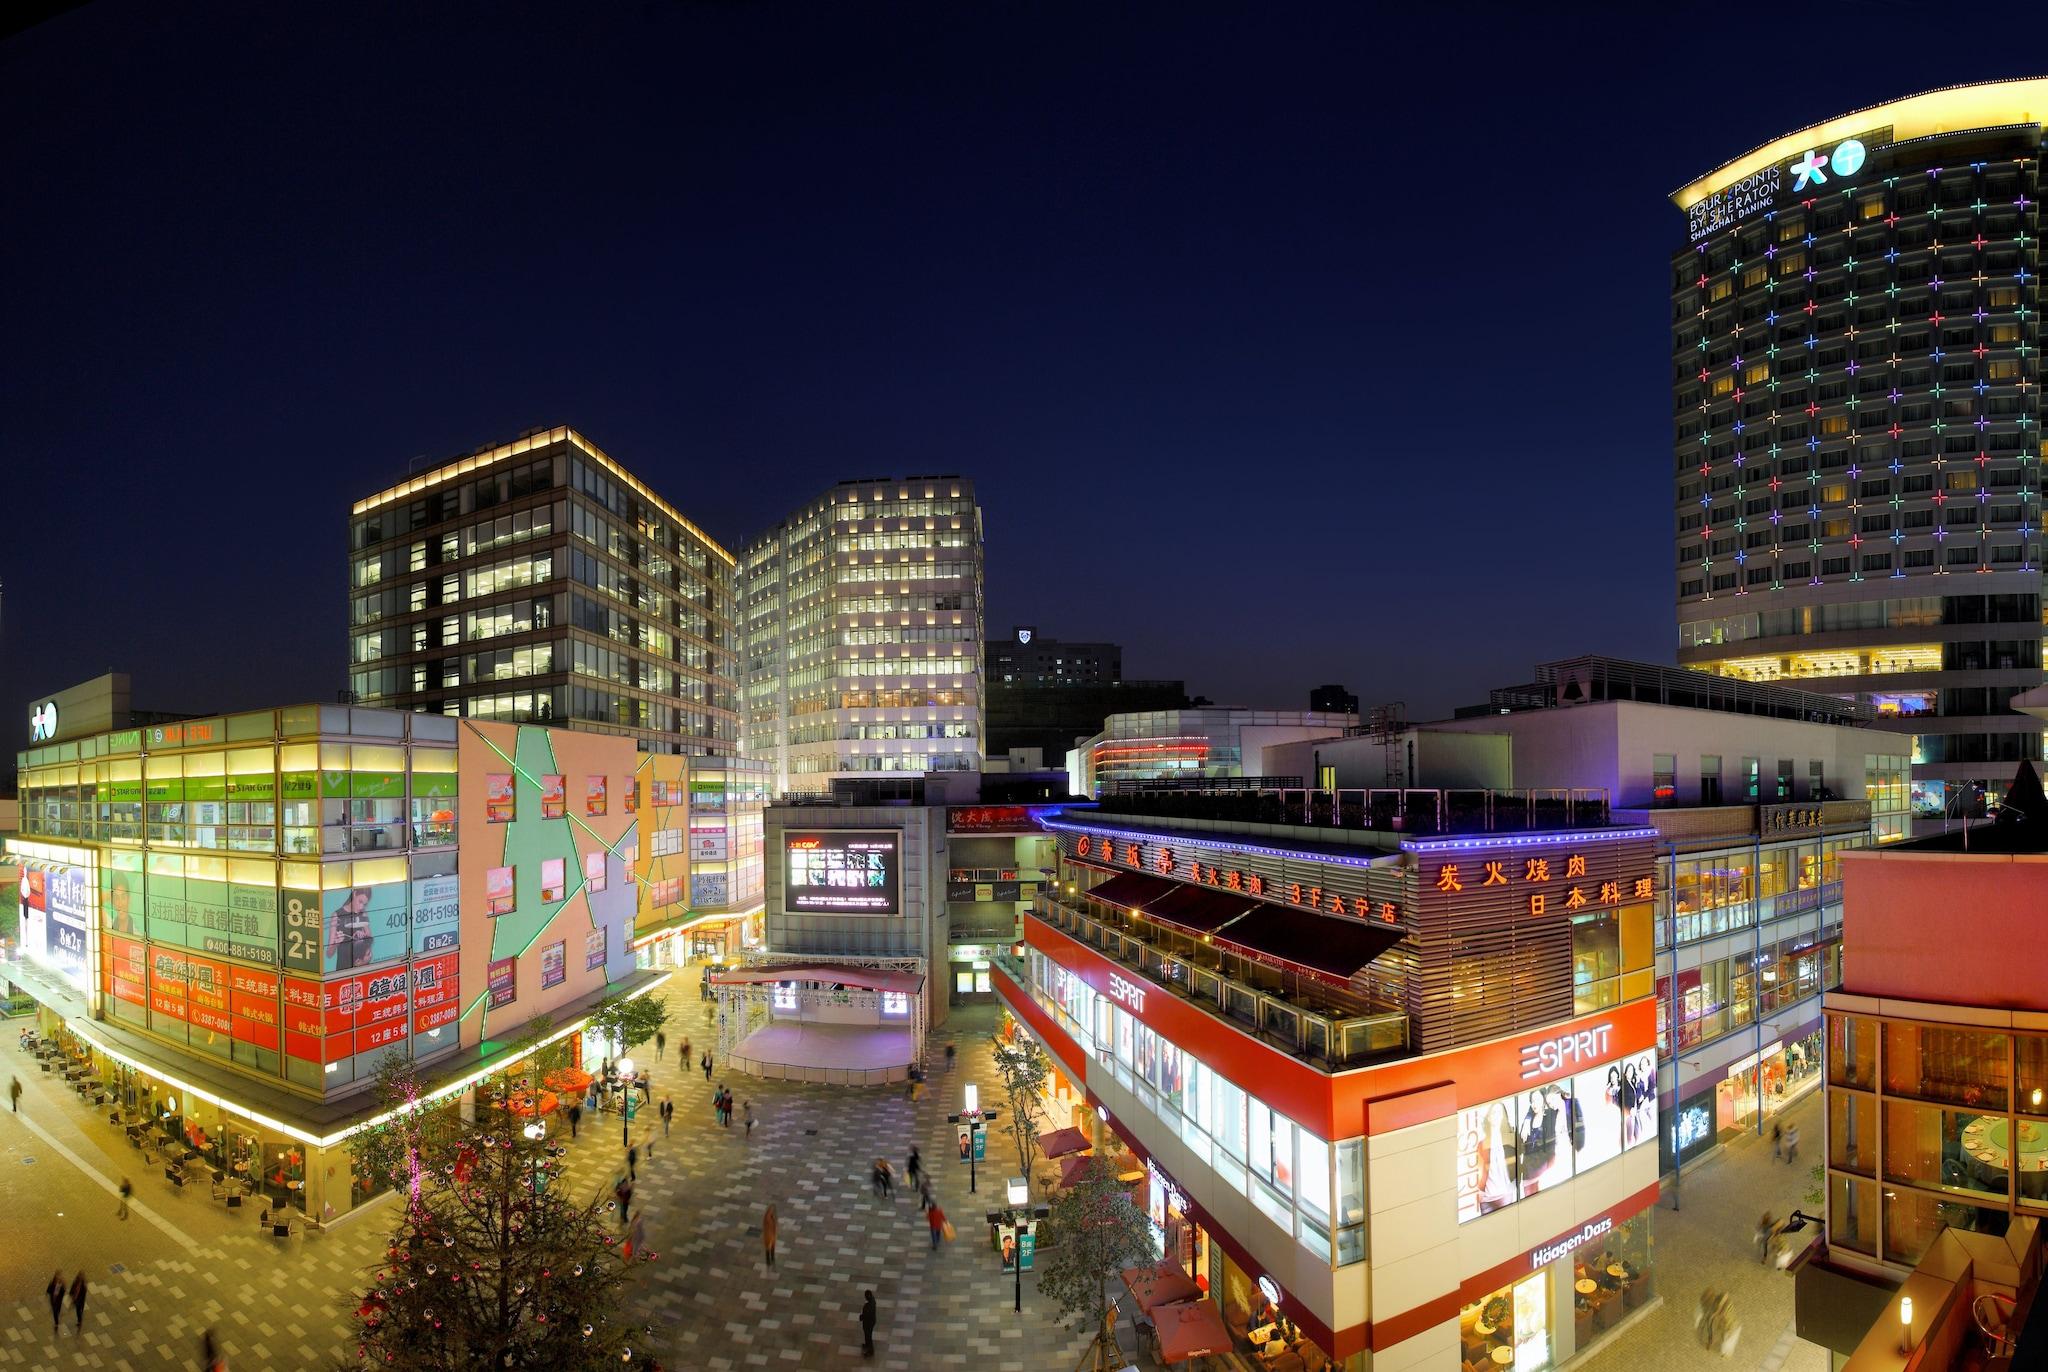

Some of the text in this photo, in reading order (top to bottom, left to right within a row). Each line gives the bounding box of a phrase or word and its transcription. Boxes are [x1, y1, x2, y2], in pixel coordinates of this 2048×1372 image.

[1690, 165, 1780, 219] FOUR POINTS
[1690, 179, 1780, 232] BY SHERATON
[1738, 197, 1774, 219] DANING
[1437, 854, 1587, 892] 炭火烧肉
[288, 898, 320, 929] 8座
[1530, 877, 1653, 916] 日本料理
[202, 907, 259, 937] 值得信赖
[213, 940, 273, 962] 400-881-5198
[288, 931, 317, 960] 2F
[1109, 972, 1146, 1013] ESPRIT
[1519, 1024, 1614, 1080] ESPRIT
[1457, 1110, 1481, 1214] ESPRIT
[1022, 1249, 1032, 1257] 2F
[1532, 1217, 1612, 1270] Häagen-Dazs
